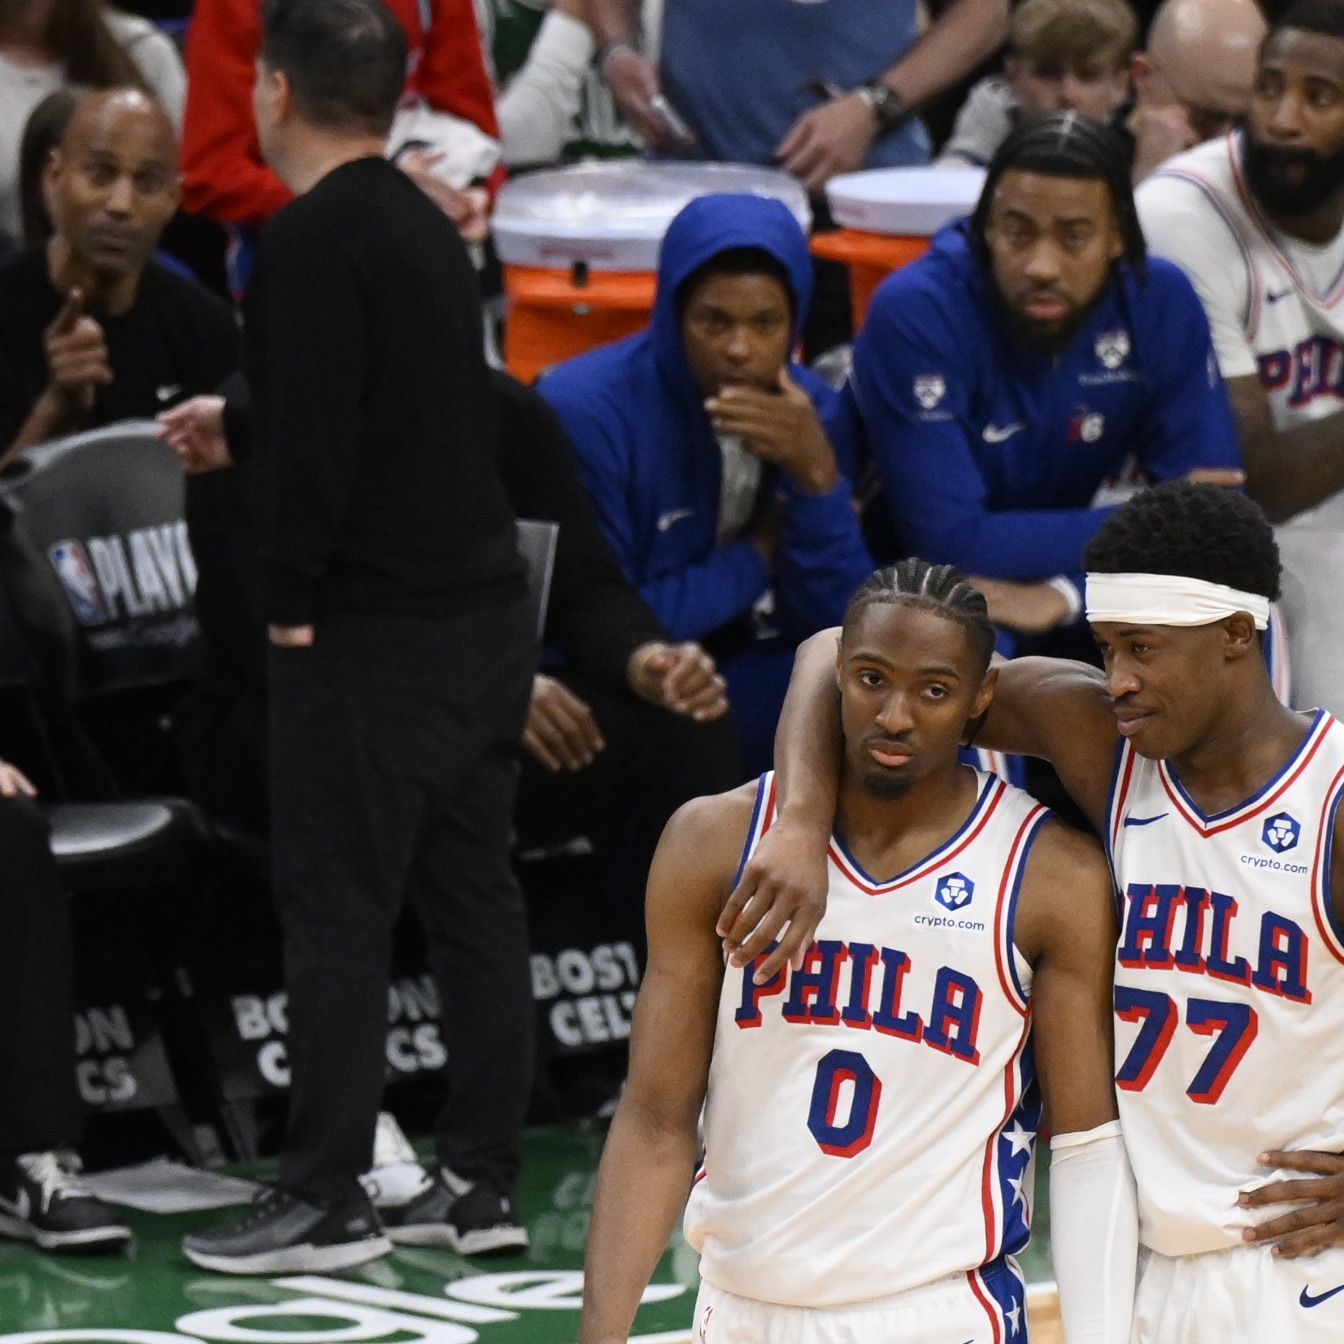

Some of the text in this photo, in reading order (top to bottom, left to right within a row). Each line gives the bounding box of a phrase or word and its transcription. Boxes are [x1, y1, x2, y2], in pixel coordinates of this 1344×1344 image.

[1240, 853, 1308, 876] crypto.com
[914, 914, 986, 933] crypto.com
[1118, 882, 1313, 1006] HILA
[734, 939, 984, 1067] PHILA
[1113, 984, 1259, 1106] 77
[806, 1048, 883, 1159] 0
